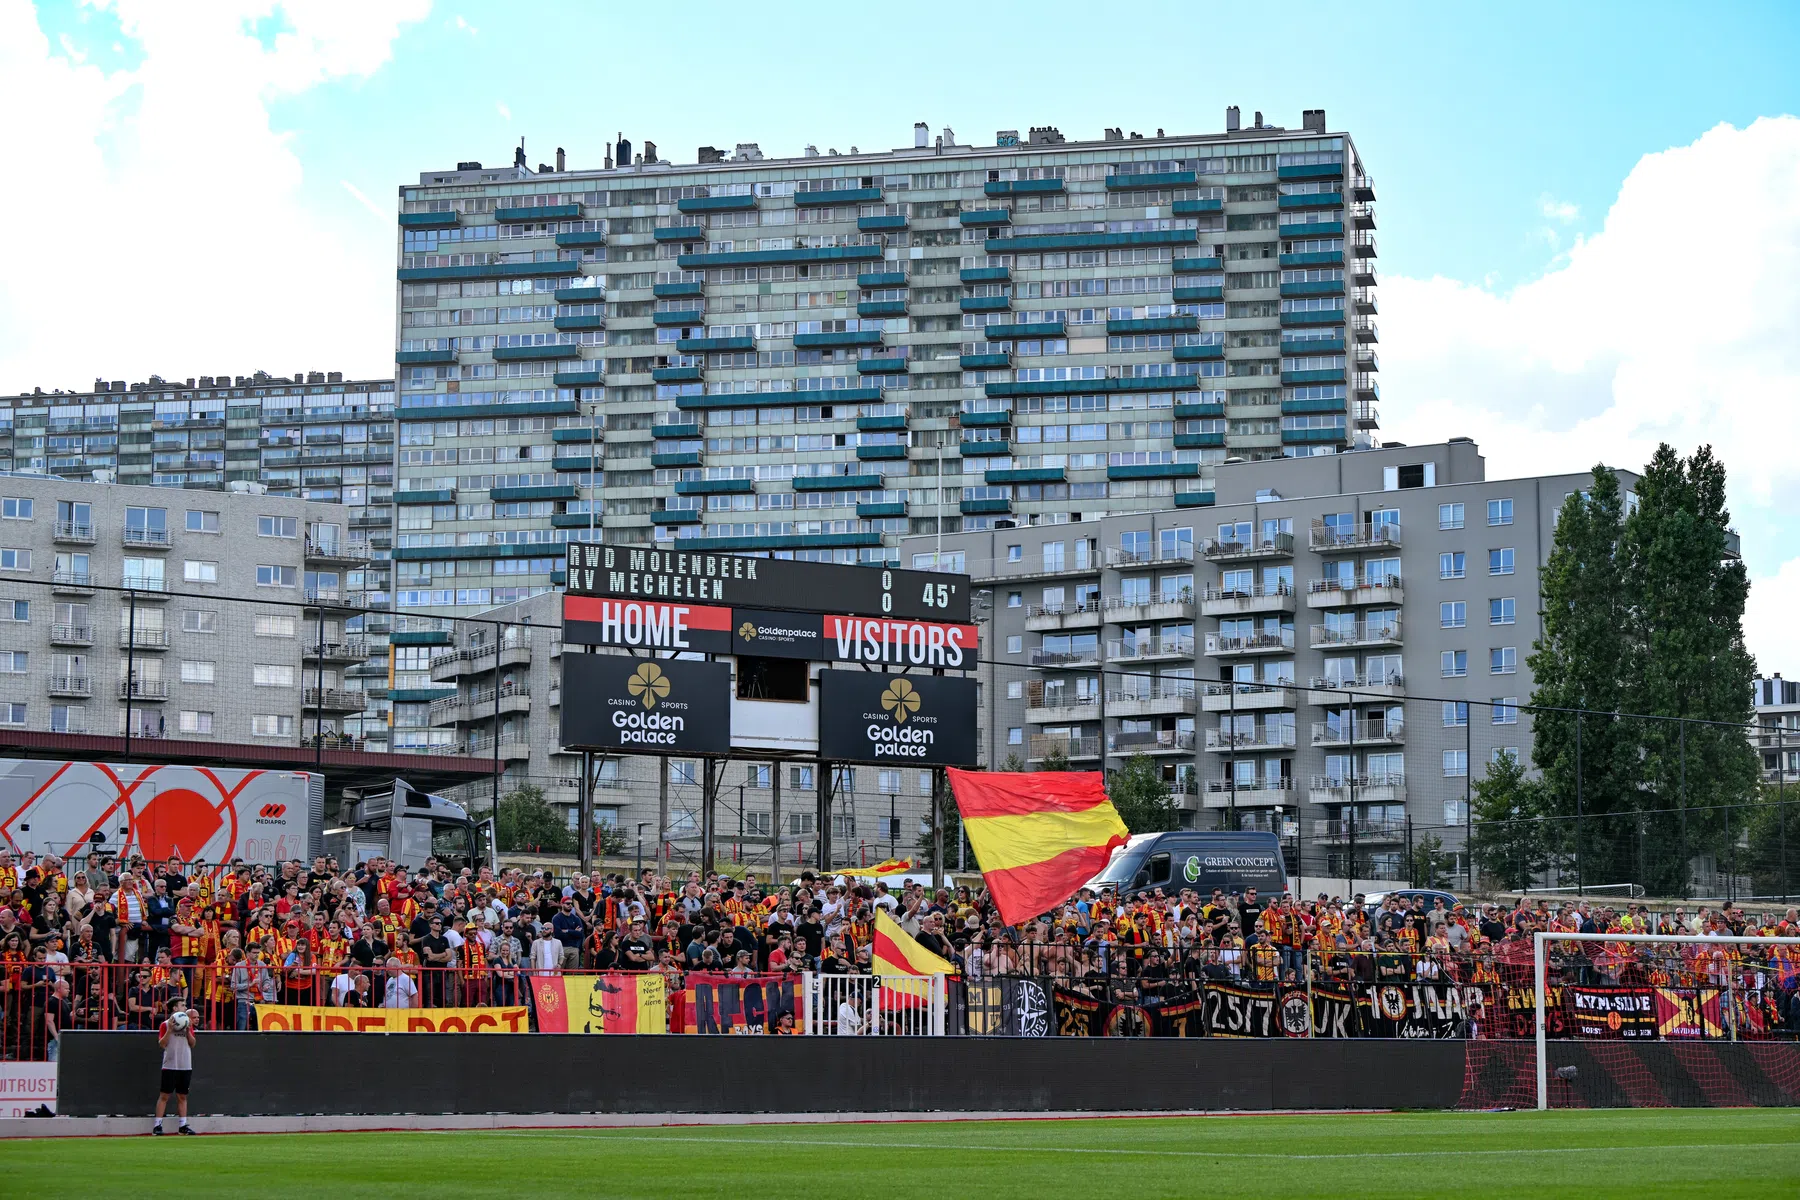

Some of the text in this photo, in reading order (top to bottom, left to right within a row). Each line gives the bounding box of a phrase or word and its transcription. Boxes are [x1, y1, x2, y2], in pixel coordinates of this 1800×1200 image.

[570, 545, 757, 580] RWD MOLENBEEK
[570, 568, 723, 599] KV MECHELEN
[882, 570, 892, 590] 0
[882, 593, 892, 612] 0
[922, 583, 956, 608] 45'
[602, 602, 690, 648] HOME
[834, 618, 963, 667] VISITORS
[607, 698, 688, 710] CASINO SPORTS
[612, 710, 684, 731] Golden
[862, 712, 938, 724] CASINO SPORTS
[620, 729, 676, 745] palace
[867, 724, 934, 744] Golden
[875, 742, 927, 757] palace
[1204, 857, 1274, 867] GREEN CONCEPT
[873, 975, 881, 988] 2
[1207, 991, 1273, 1036] 25/7
